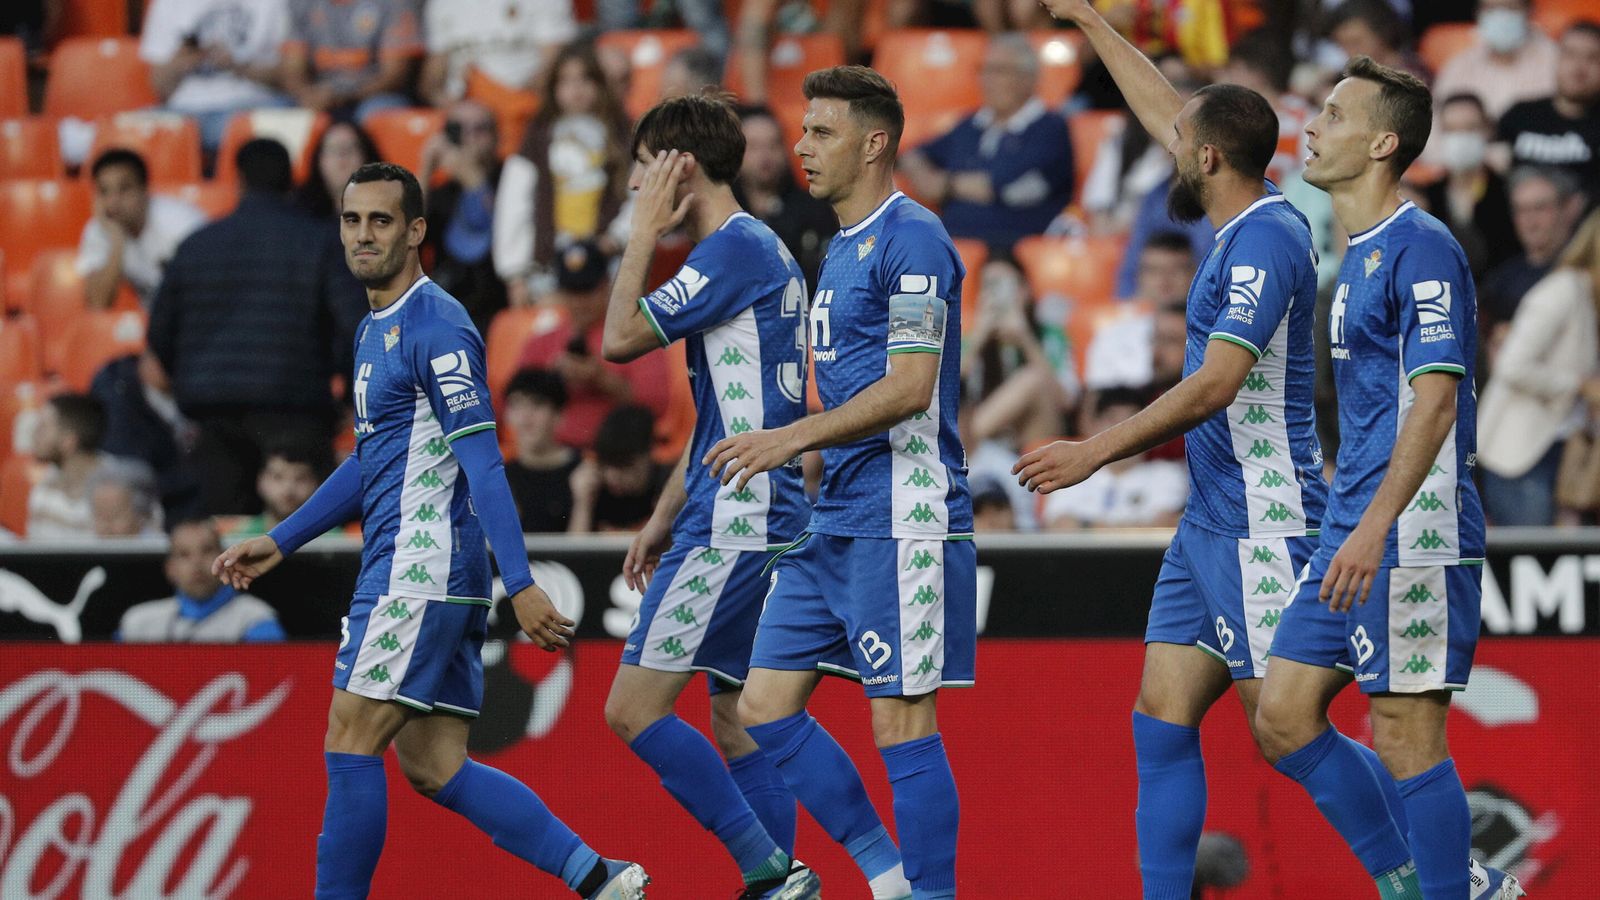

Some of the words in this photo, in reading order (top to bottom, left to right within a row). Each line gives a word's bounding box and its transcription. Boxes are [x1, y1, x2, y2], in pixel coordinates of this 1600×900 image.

[653, 290, 682, 311] REALE
[446, 390, 479, 408] REALE
[449, 399, 481, 414] SEGUROS
